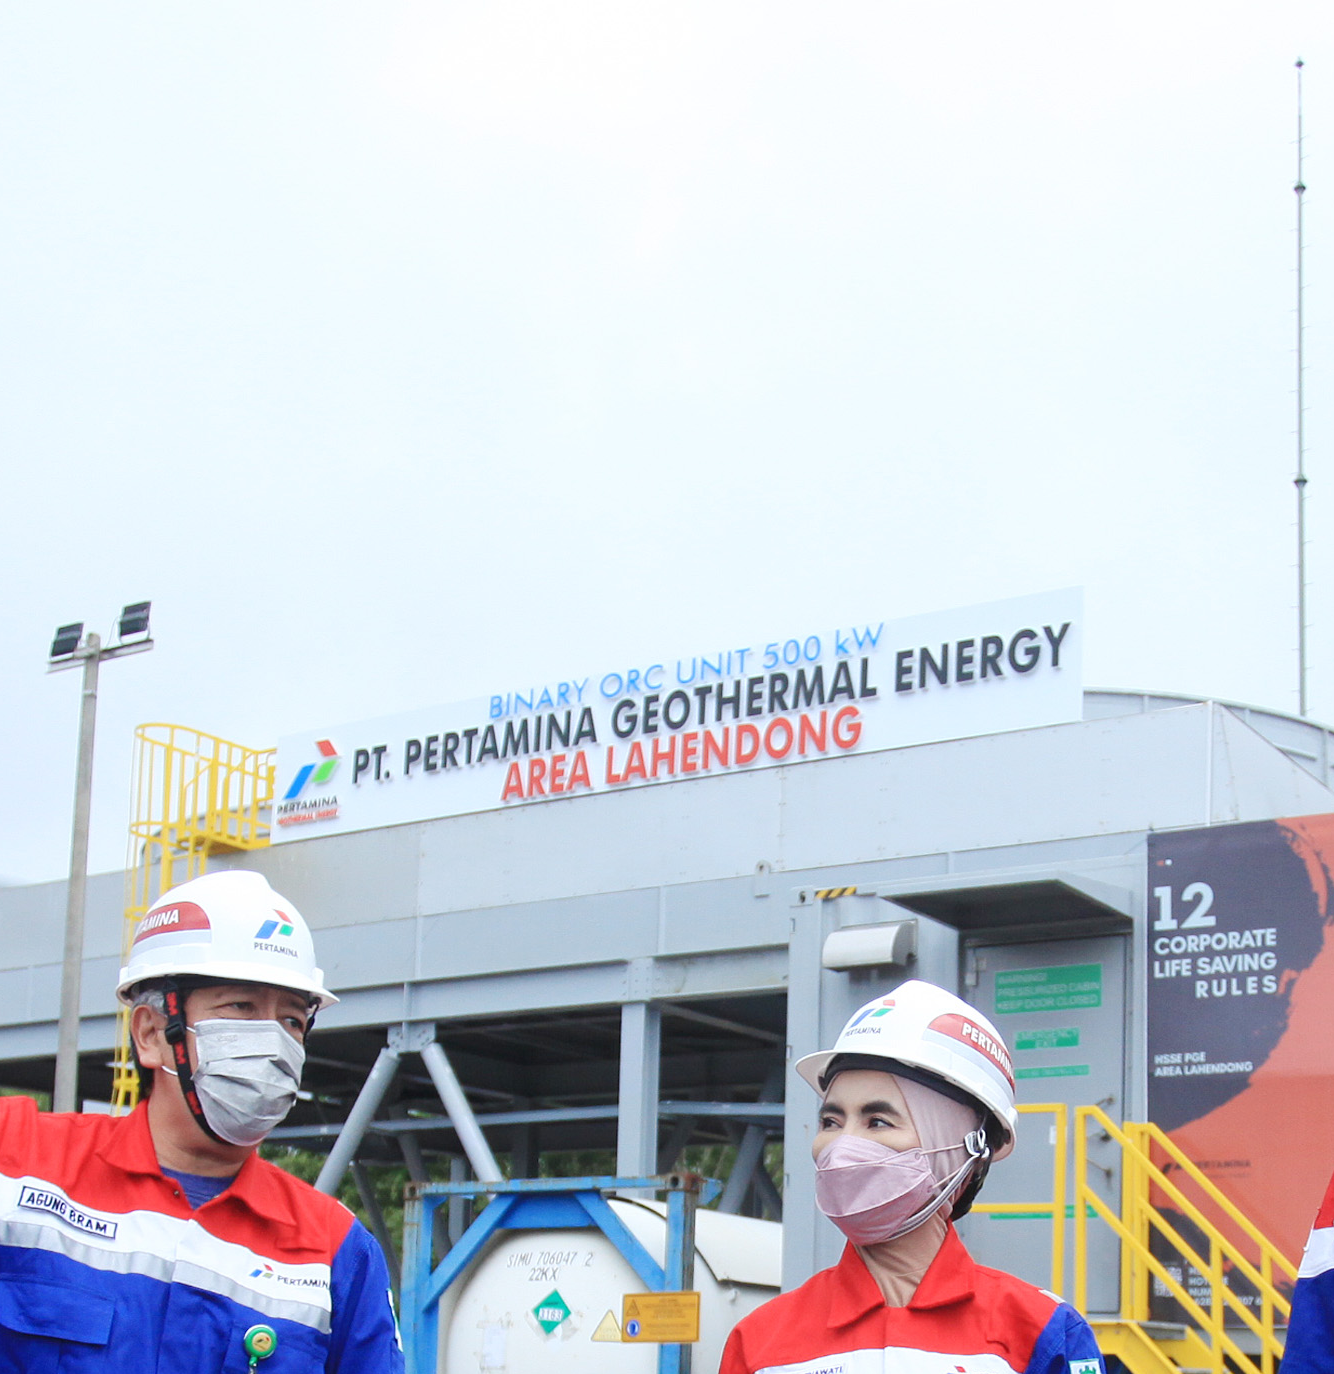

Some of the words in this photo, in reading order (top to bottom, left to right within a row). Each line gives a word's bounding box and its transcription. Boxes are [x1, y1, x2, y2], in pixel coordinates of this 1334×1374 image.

[489, 677, 589, 719] BINARY
[600, 664, 664, 699] ORC
[677, 648, 750, 684] UNIT
[762, 635, 822, 669] 500
[835, 622, 884, 656] kW
[352, 745, 390, 785] PT.
[404, 706, 598, 776] PERTAMINA
[611, 656, 878, 739] GEOTHERMAL
[895, 622, 1072, 693] ENERGY
[501, 749, 592, 801] AREA
[605, 705, 863, 784] LAHENDONG
[276, 794, 338, 815] PERTAMINA
[1153, 881, 1217, 931] 12
[254, 942, 299, 958] PERTAMINA
[1154, 928, 1277, 955] CORPORATE
[1153, 958, 1192, 979] LIFE
[1196, 951, 1278, 975] SAVING
[1195, 975, 1278, 999] RULES
[1154, 1053, 1182, 1066] HSSE
[1184, 1051, 1207, 1064] PGE
[1154, 1065, 1183, 1078] AREA
[1184, 1061, 1254, 1076] LAHENDONG
[26, 1192, 67, 1215] AGUNG
[69, 1209, 107, 1234] BRAM
[537, 1250, 578, 1266] 706047
[584, 1251, 594, 1267] 2
[277, 1274, 329, 1289] PERTAMIN
